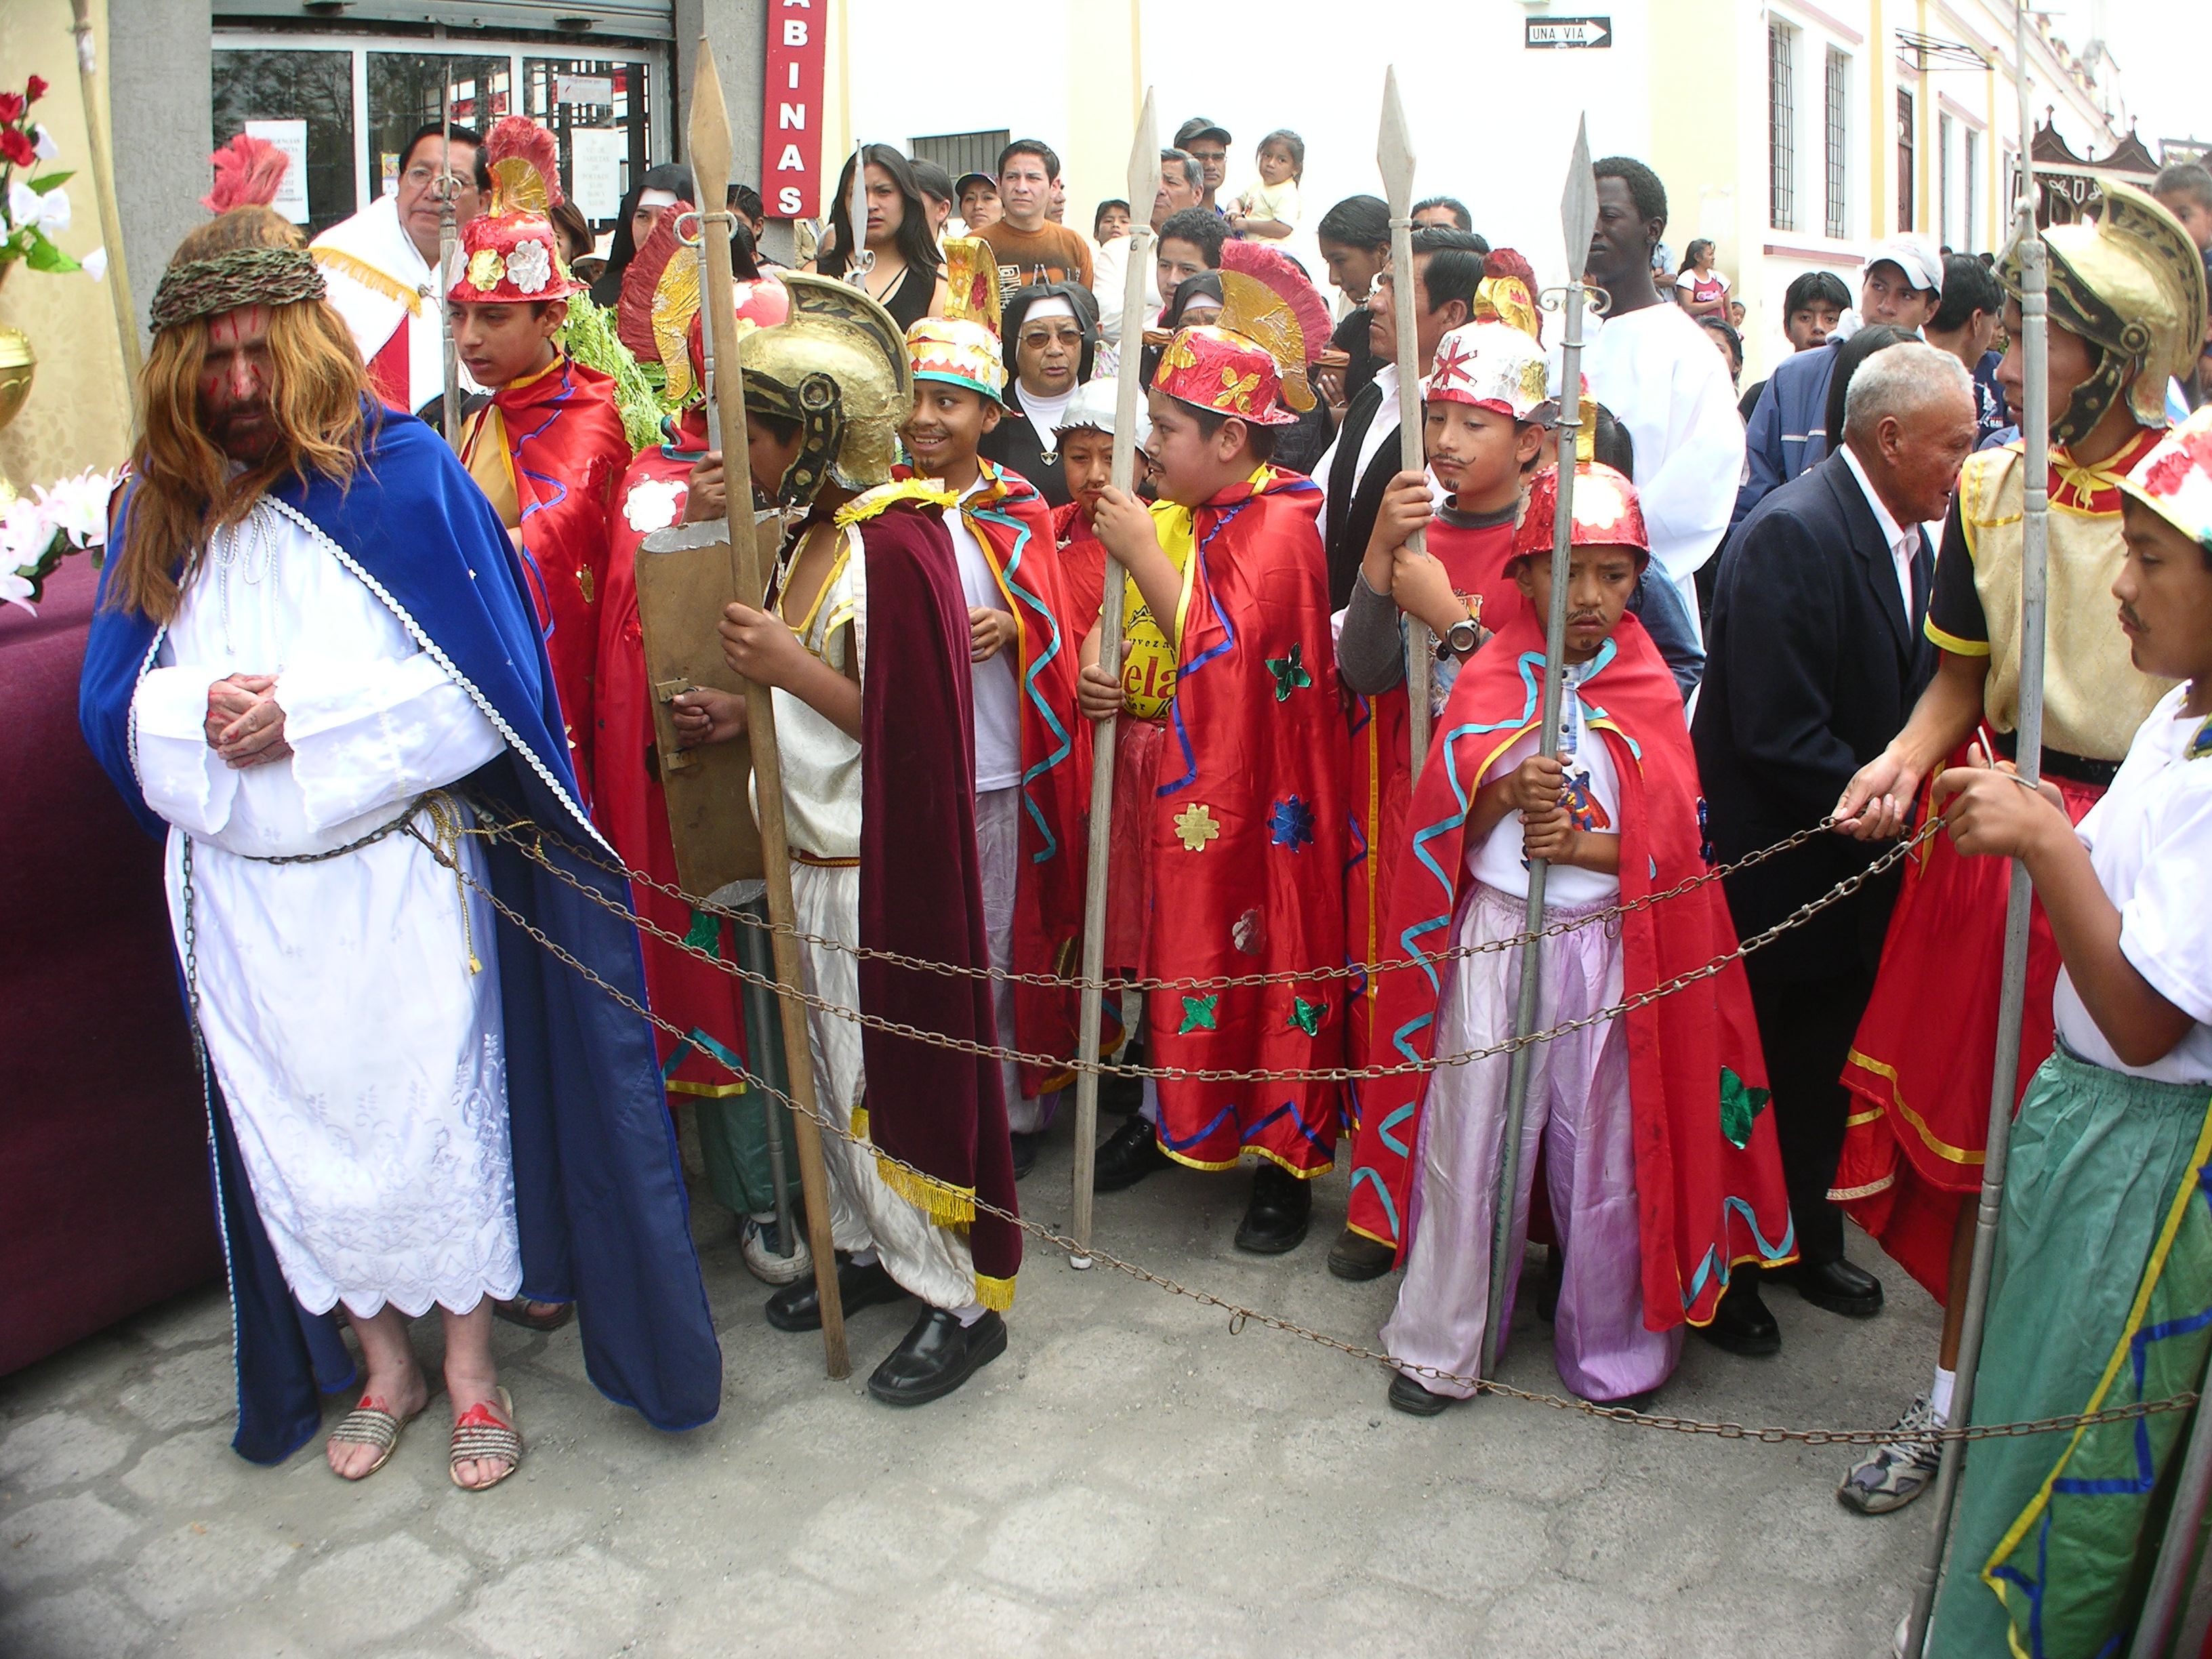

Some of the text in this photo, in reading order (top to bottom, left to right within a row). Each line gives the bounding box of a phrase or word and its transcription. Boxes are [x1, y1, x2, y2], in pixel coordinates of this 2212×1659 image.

[1533, 27, 1584, 39] UNA VIA
[777, 0, 811, 215] BINAS
